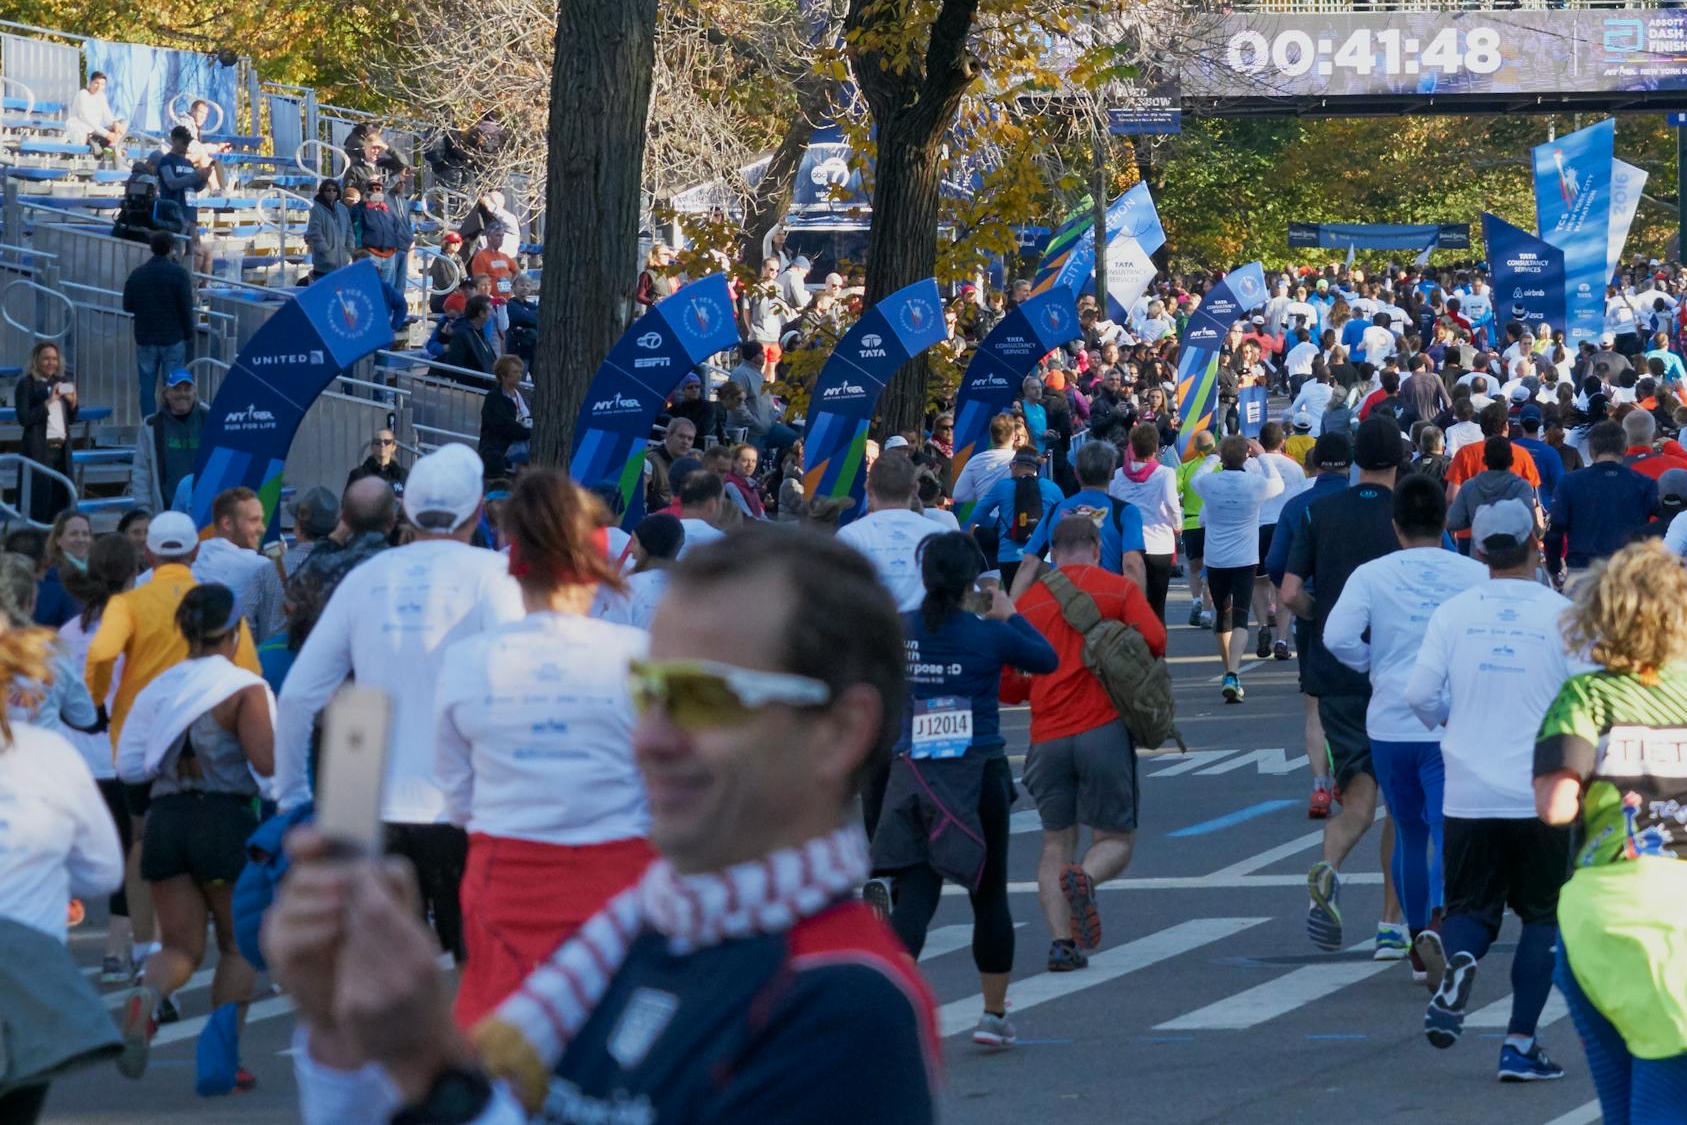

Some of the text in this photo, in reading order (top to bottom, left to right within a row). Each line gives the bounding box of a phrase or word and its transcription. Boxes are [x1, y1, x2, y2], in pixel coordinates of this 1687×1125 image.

[1648, 18, 1684, 26] ABBOTT
[1649, 27, 1684, 39] DASH
[1227, 27, 1502, 76] 00:41:48
[1640, 67, 1658, 75] NEW
[1660, 67, 1681, 75] YORK
[1506, 259, 1549, 267] CONSULTANCY
[1523, 289, 1545, 297] airbnb
[859, 349, 887, 359] TATA
[252, 354, 308, 366] UNITED
[634, 356, 671, 368] ESPN
[224, 423, 241, 431] RUN
[242, 422, 258, 430] FOR
